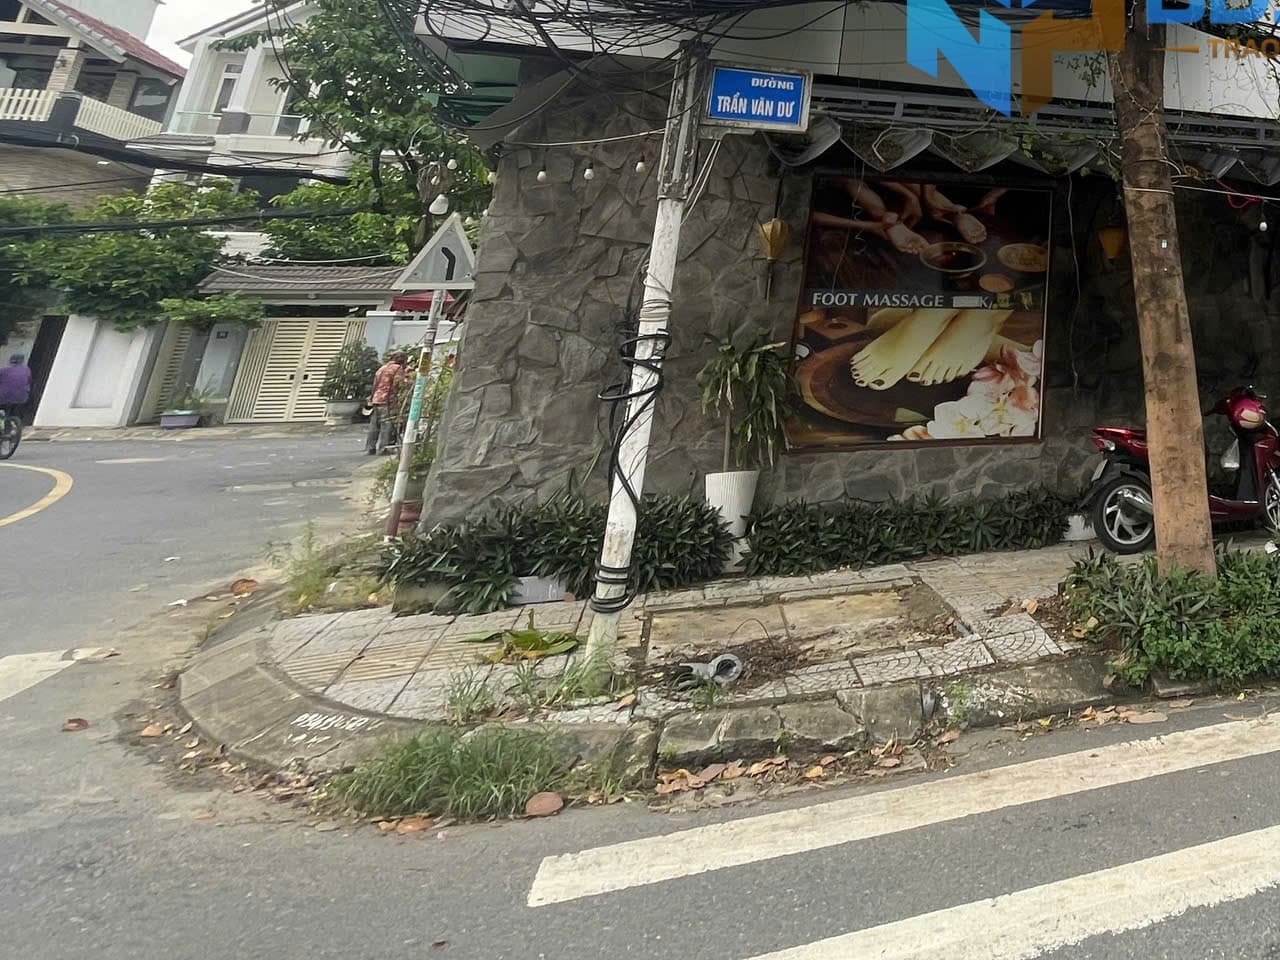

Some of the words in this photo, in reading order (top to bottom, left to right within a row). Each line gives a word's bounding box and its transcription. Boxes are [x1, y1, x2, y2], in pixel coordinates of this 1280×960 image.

[751, 77, 795, 90] ĐƯỜNG
[751, 97, 774, 117] VĂN
[777, 101, 796, 118] DƯ
[812, 292, 859, 306] FOOT
[863, 293, 944, 307] MASSAGE
